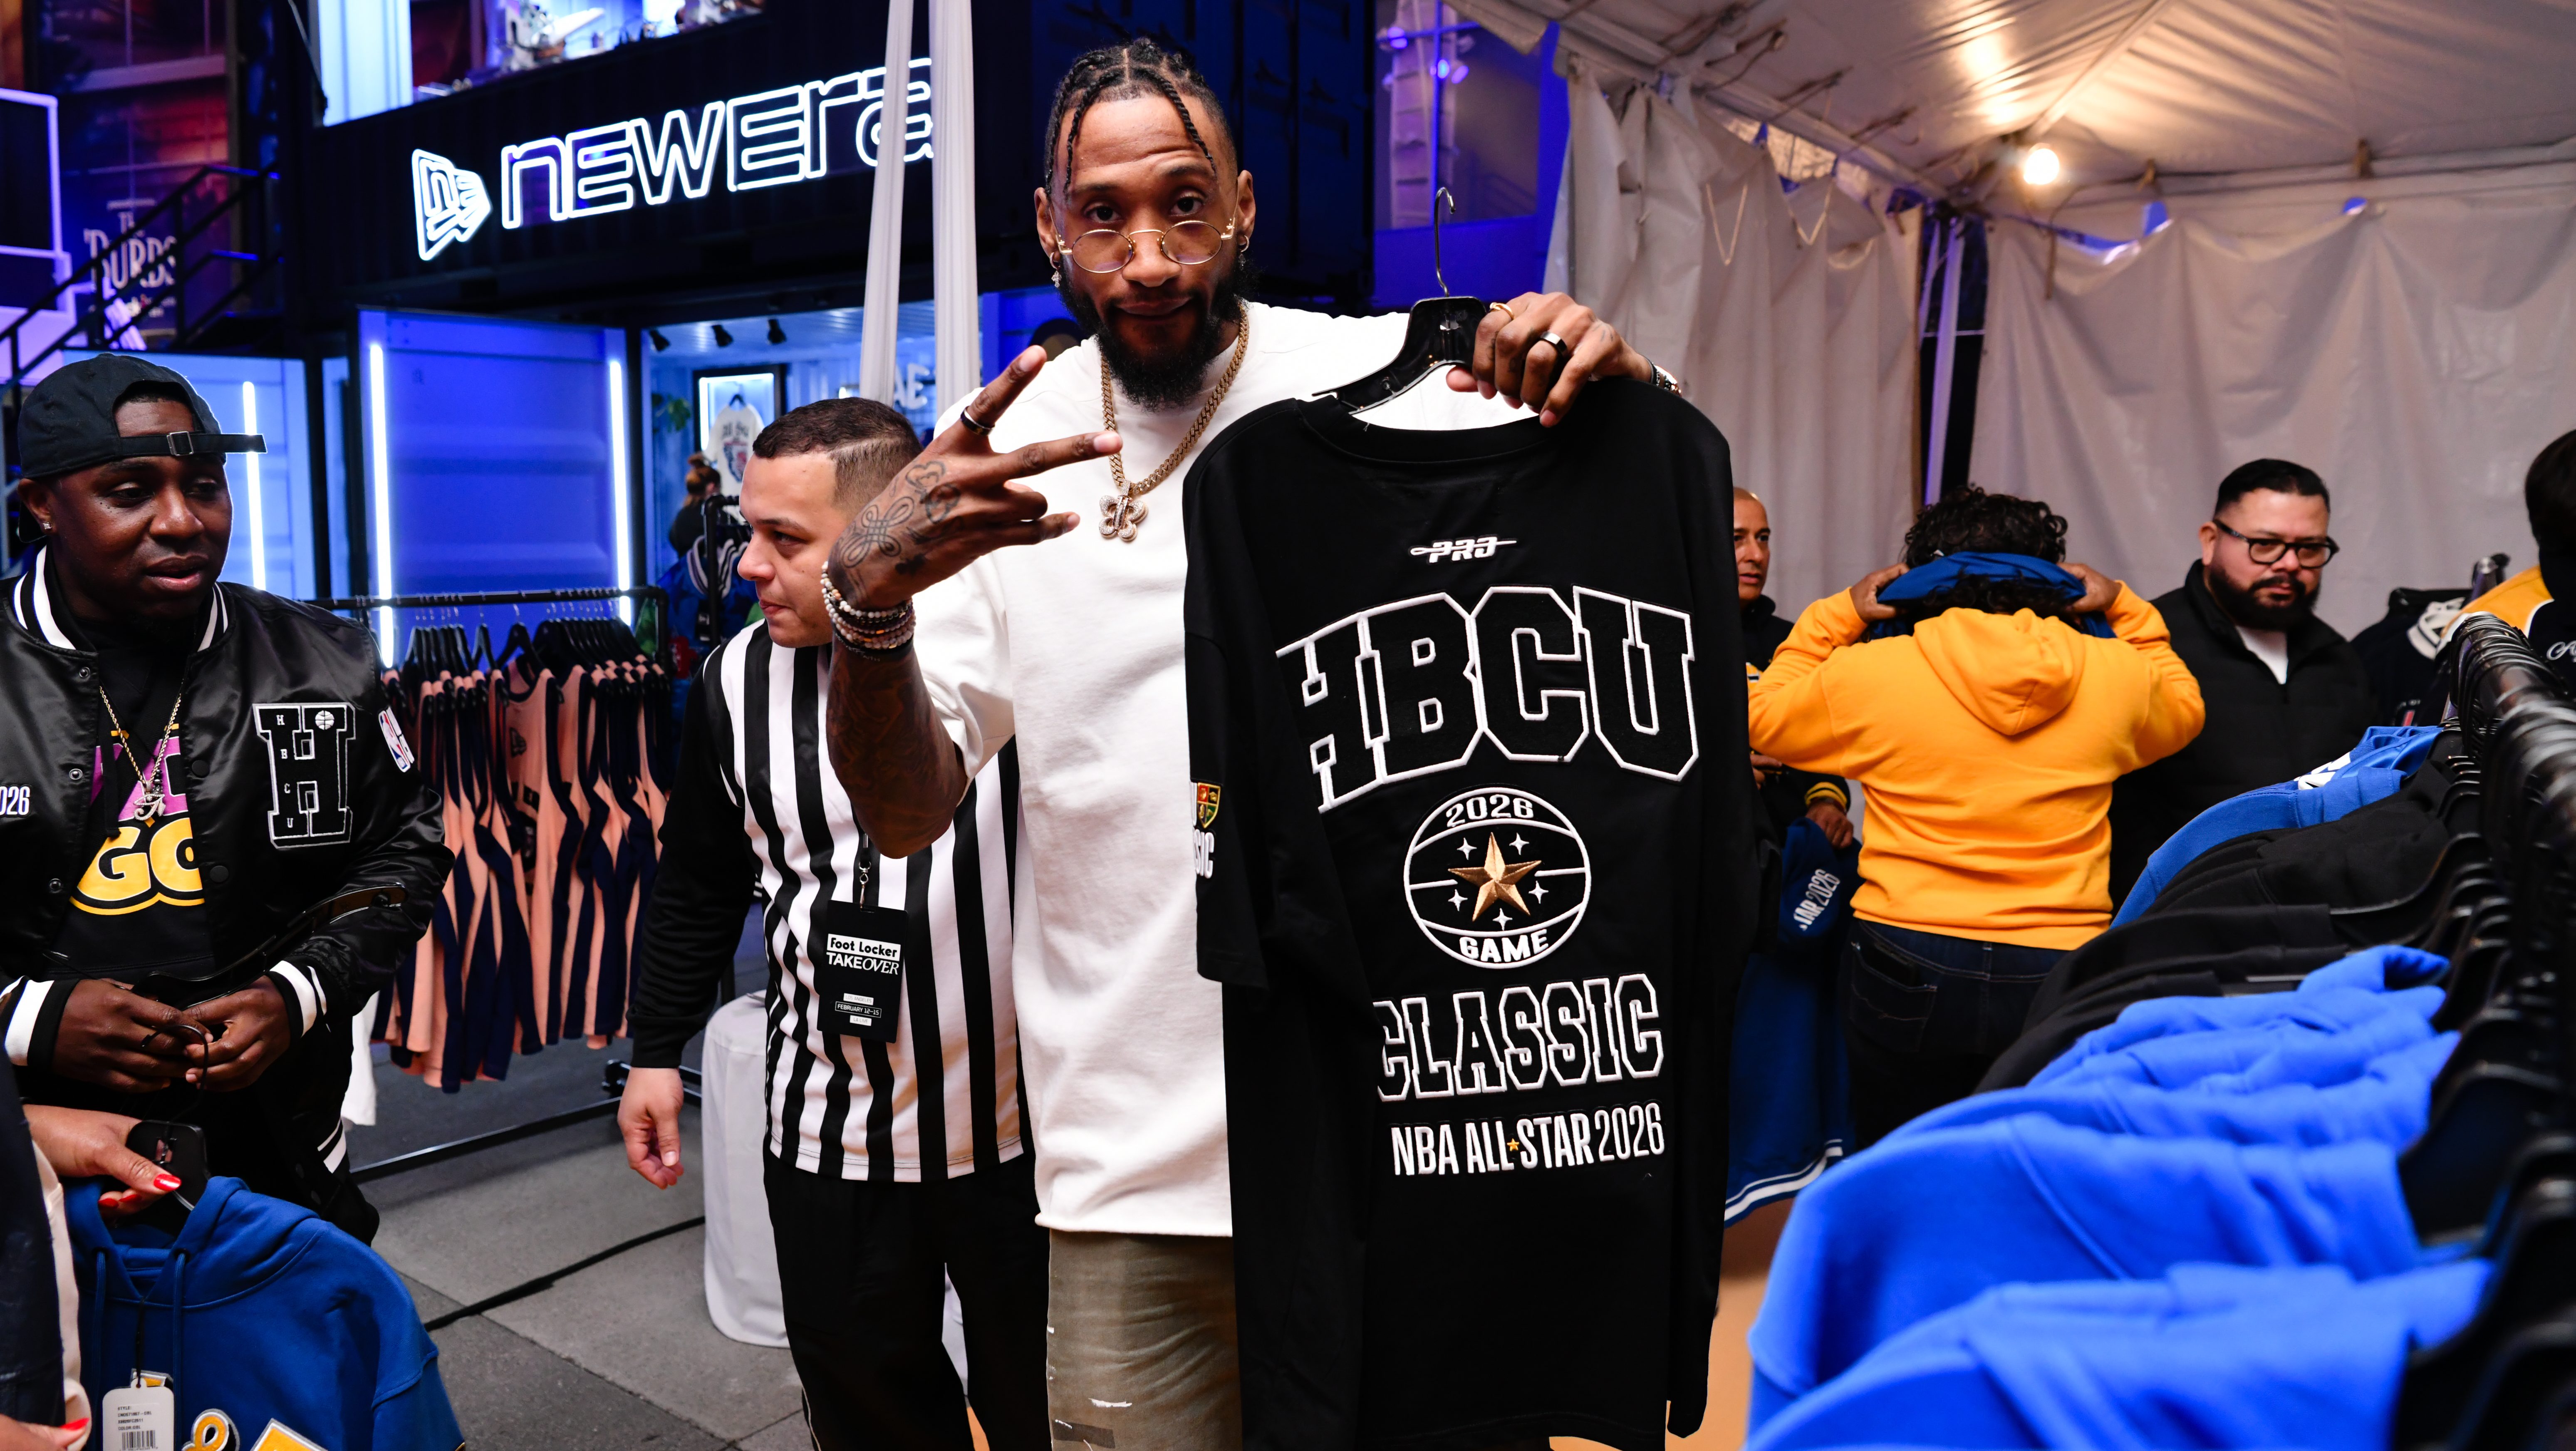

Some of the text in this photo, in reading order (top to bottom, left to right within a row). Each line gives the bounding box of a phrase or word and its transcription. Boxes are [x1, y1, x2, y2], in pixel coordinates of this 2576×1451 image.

[1429, 536, 1498, 563] PRO
[1276, 586, 1698, 814] HBCU
[1446, 795, 1534, 827] 2026
[1805, 869, 1840, 906] 2026
[830, 937, 897, 957] Foot Locker
[1459, 929, 1550, 963] GAME
[826, 952, 899, 975] TAKEOVER
[837, 1003, 863, 1013] FEBRUARY
[1373, 973, 1664, 1102] CLASSIC
[1391, 1124, 1459, 1176] NBA
[1594, 1102, 1664, 1162] 2026
